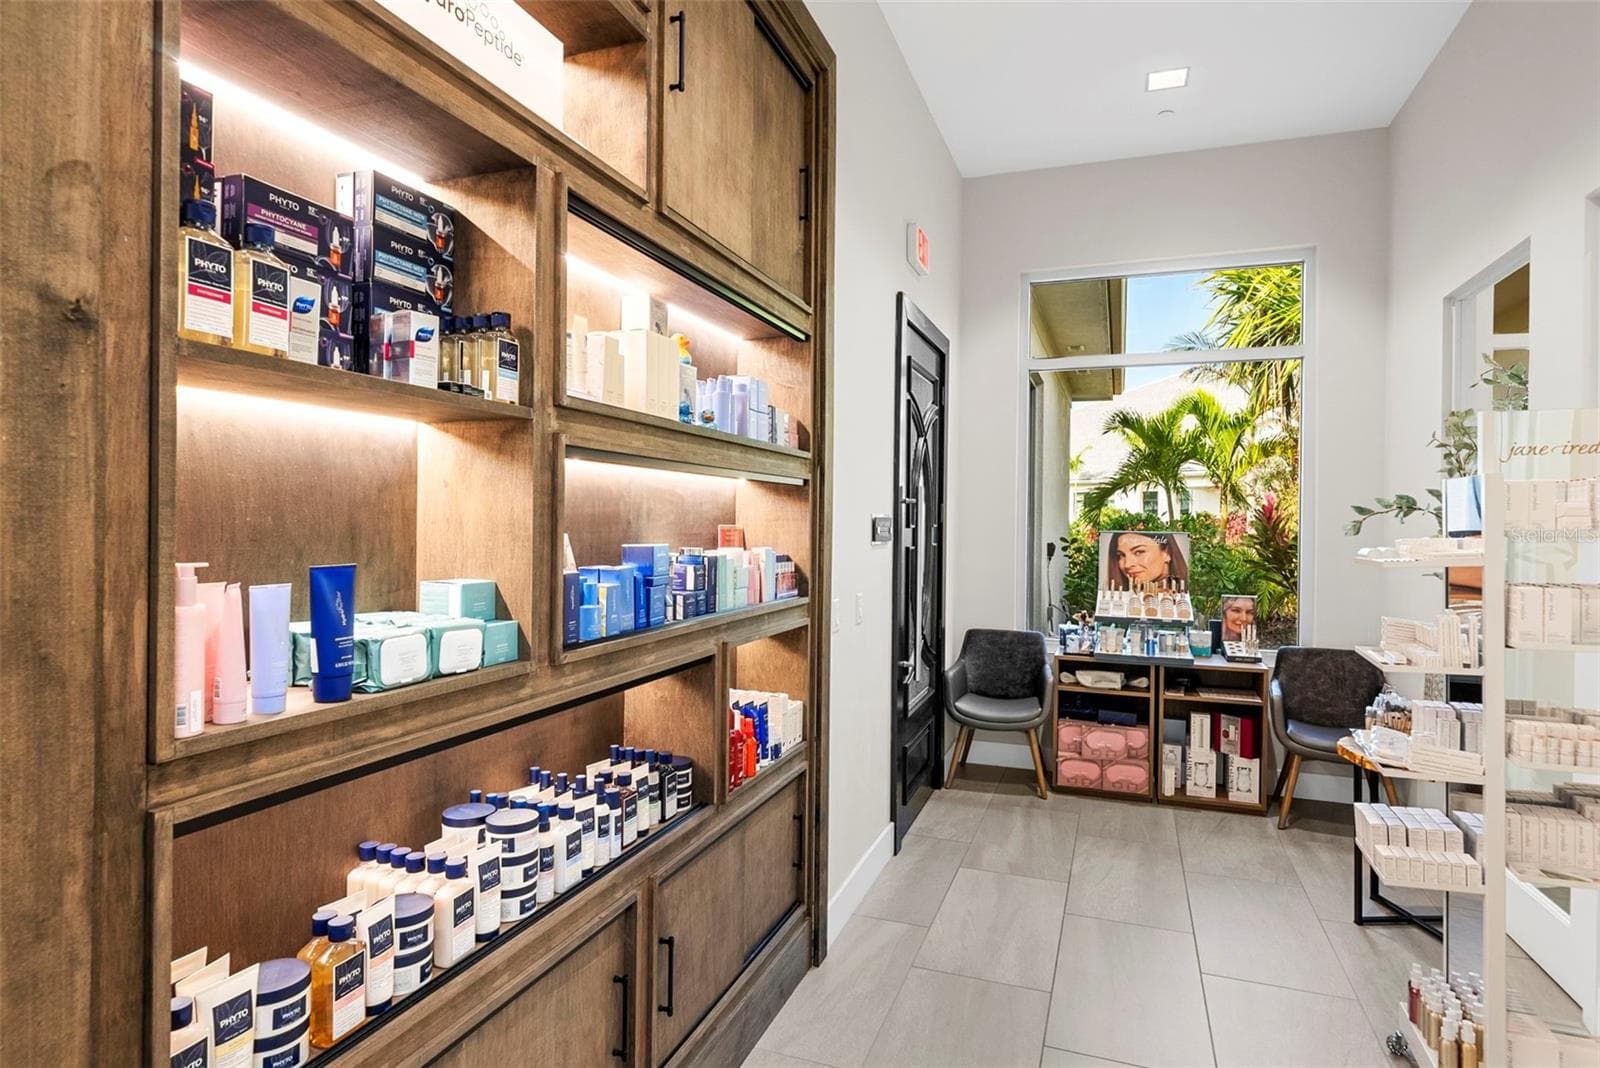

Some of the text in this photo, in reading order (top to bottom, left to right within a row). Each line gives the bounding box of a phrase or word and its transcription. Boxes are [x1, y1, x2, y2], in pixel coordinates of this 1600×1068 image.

[391, 185, 414, 201] PHYTO
[269, 192, 300, 211] PHYTO
[260, 208, 307, 231] PHYTOCYANE
[390, 240, 414, 255] PHYTO
[194, 257, 227, 274] PHYTO
[257, 277, 284, 292] PHYTO
[389, 296, 412, 309] PHYTO
[1498, 440, 1600, 463] jane ired
[482, 868, 498, 881] PHYTO
[455, 900, 472, 915] PHYTO
[373, 928, 391, 944] PHYTO
[339, 967, 361, 986] PHYTO
[220, 1008, 249, 1029] PHYTO
[282, 1006, 301, 1019] PHYTO
[272, 1055, 293, 1068] PHYTO
